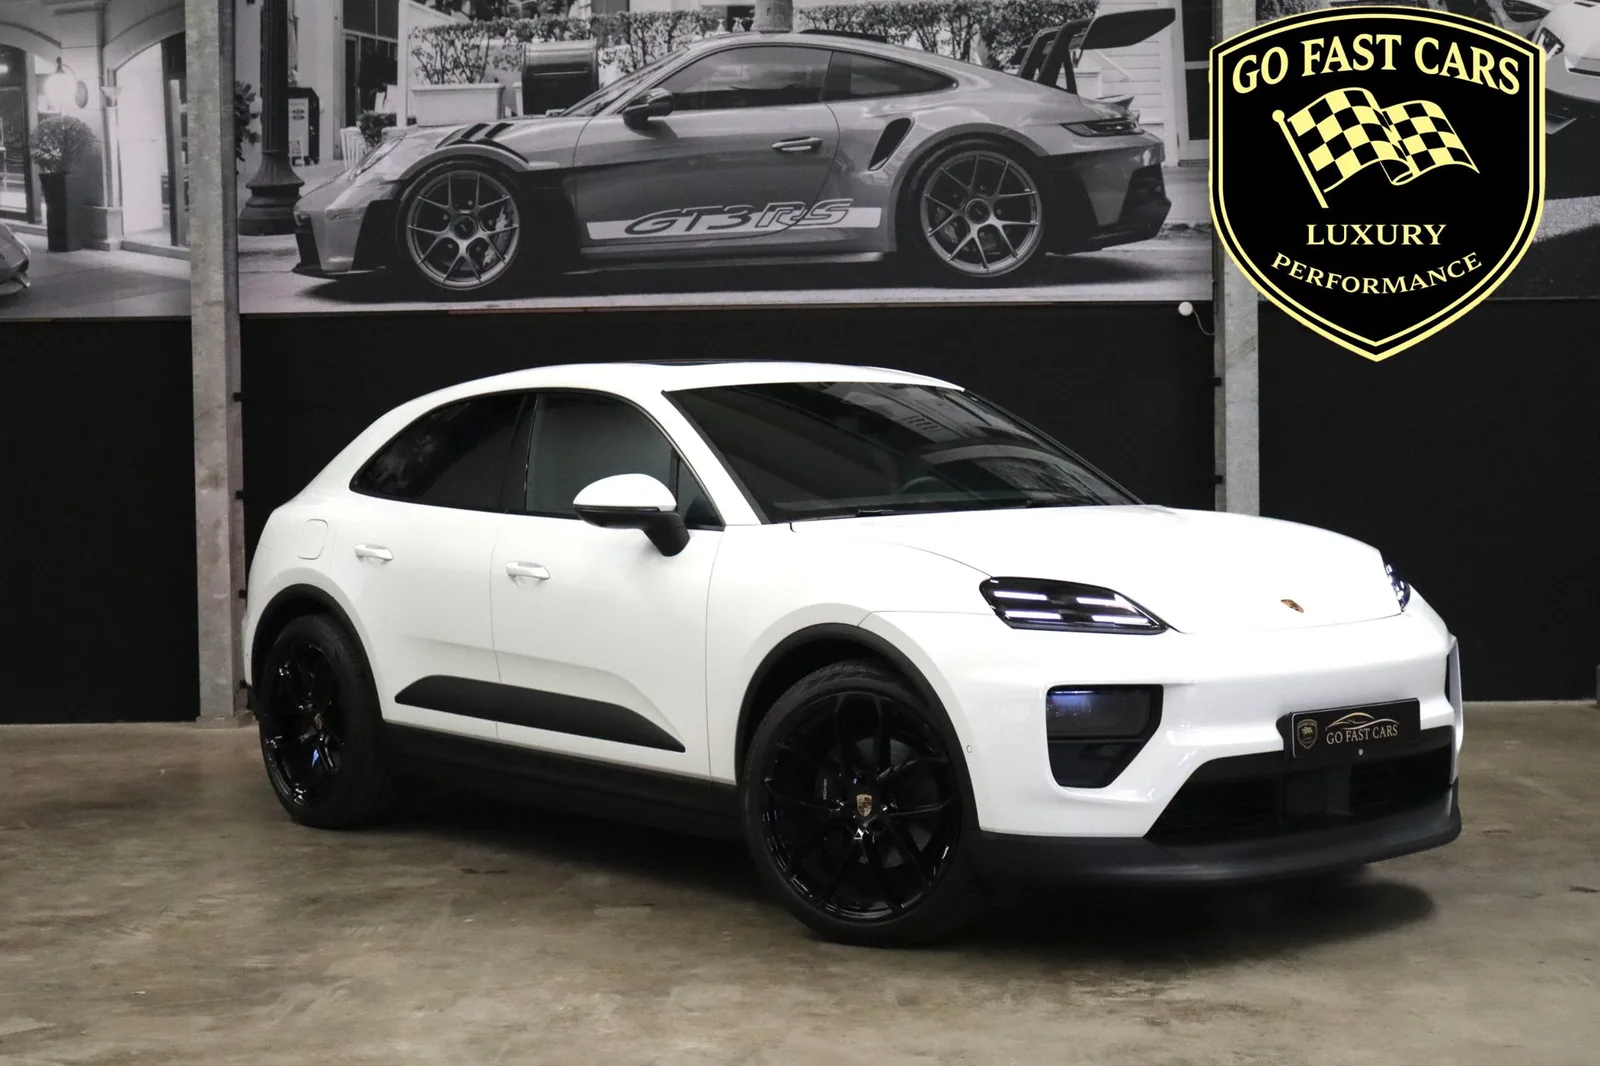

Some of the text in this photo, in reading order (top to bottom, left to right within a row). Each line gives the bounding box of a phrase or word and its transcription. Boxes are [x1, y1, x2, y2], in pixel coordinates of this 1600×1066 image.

[1326, 731, 1343, 745] GO
[1345, 728, 1370, 742] FAST
[1372, 724, 1398, 739] CARS
